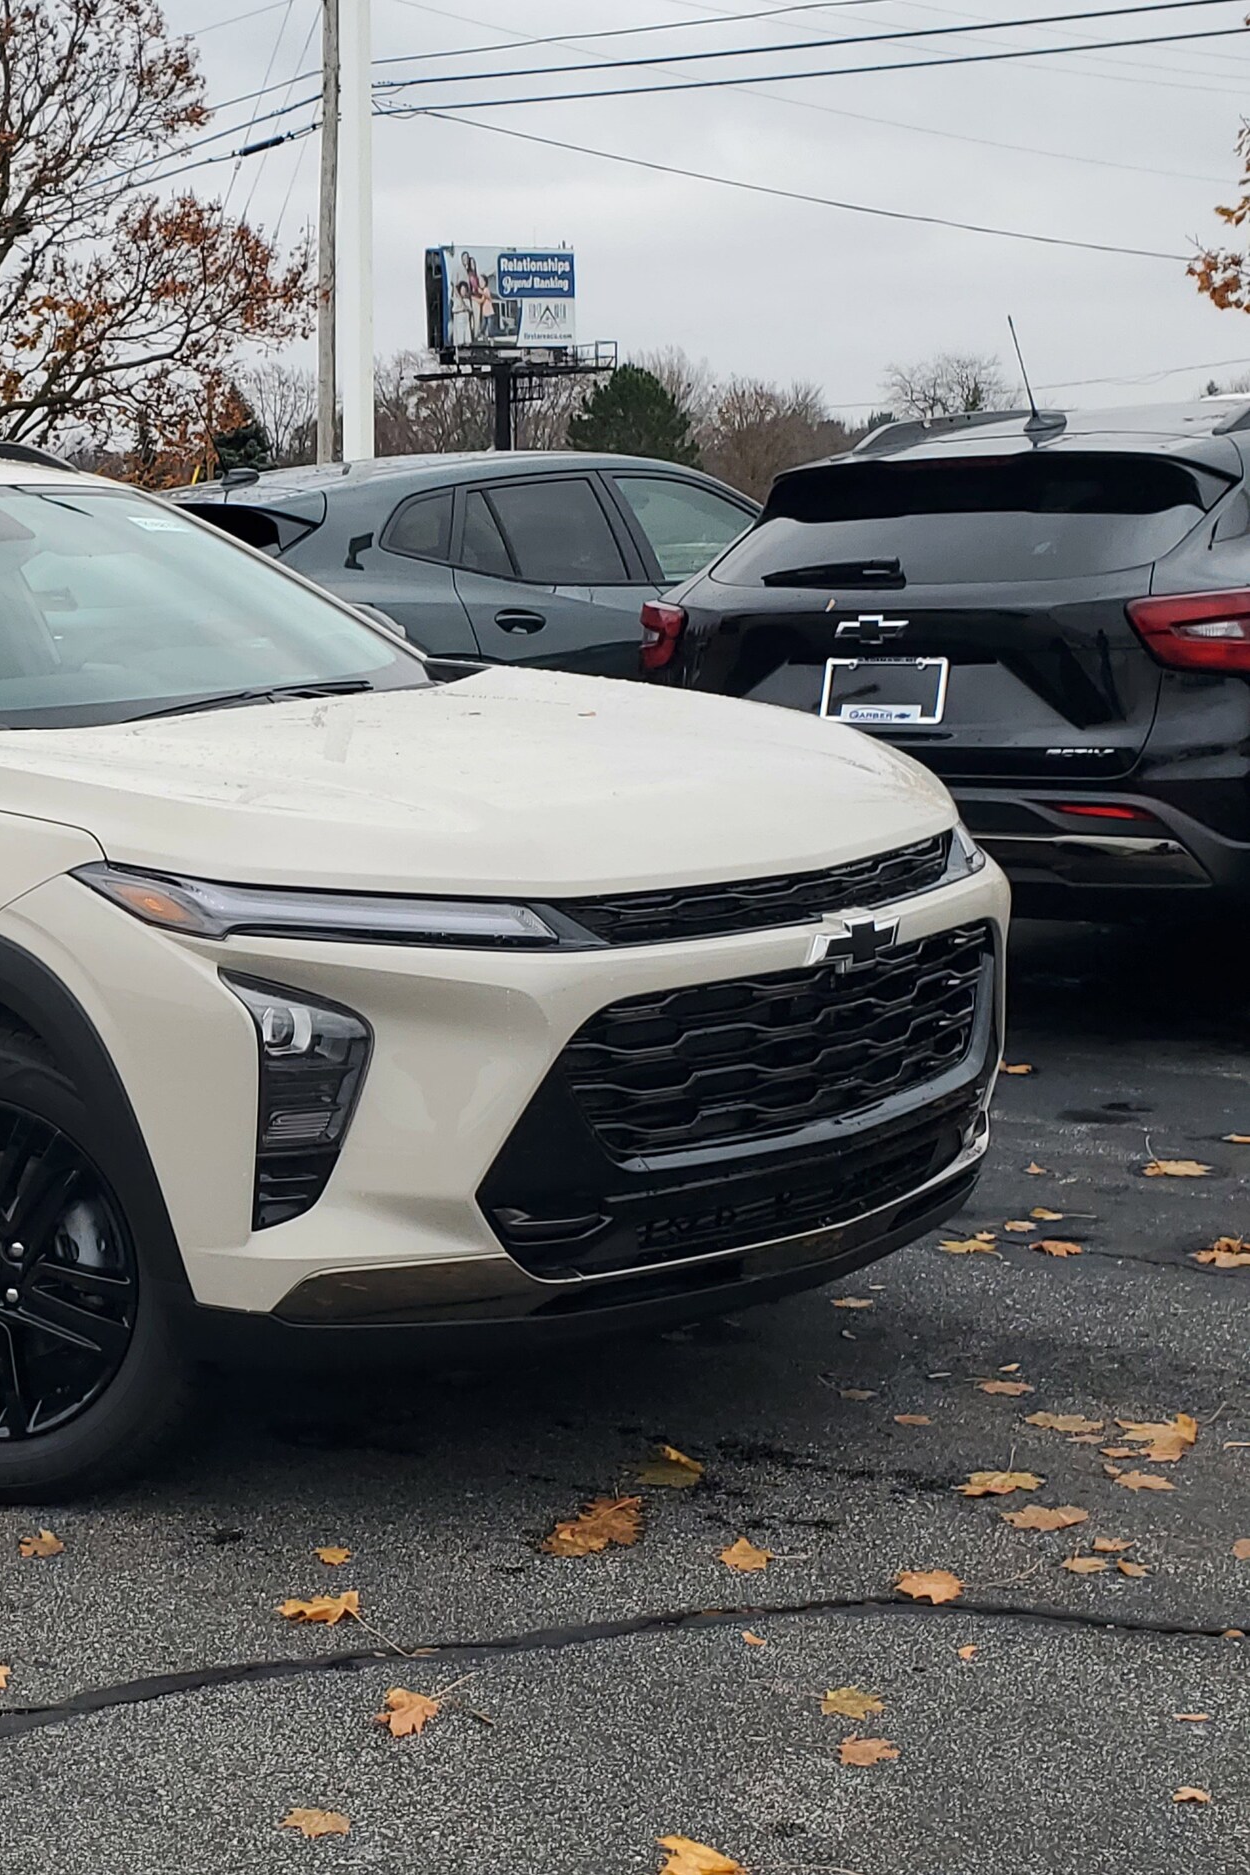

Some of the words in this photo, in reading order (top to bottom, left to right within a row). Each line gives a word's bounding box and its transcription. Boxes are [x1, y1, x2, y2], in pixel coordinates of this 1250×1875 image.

[500, 257, 570, 275] Relationships
[533, 276, 569, 292] Banking
[849, 710, 892, 720] GARBER
